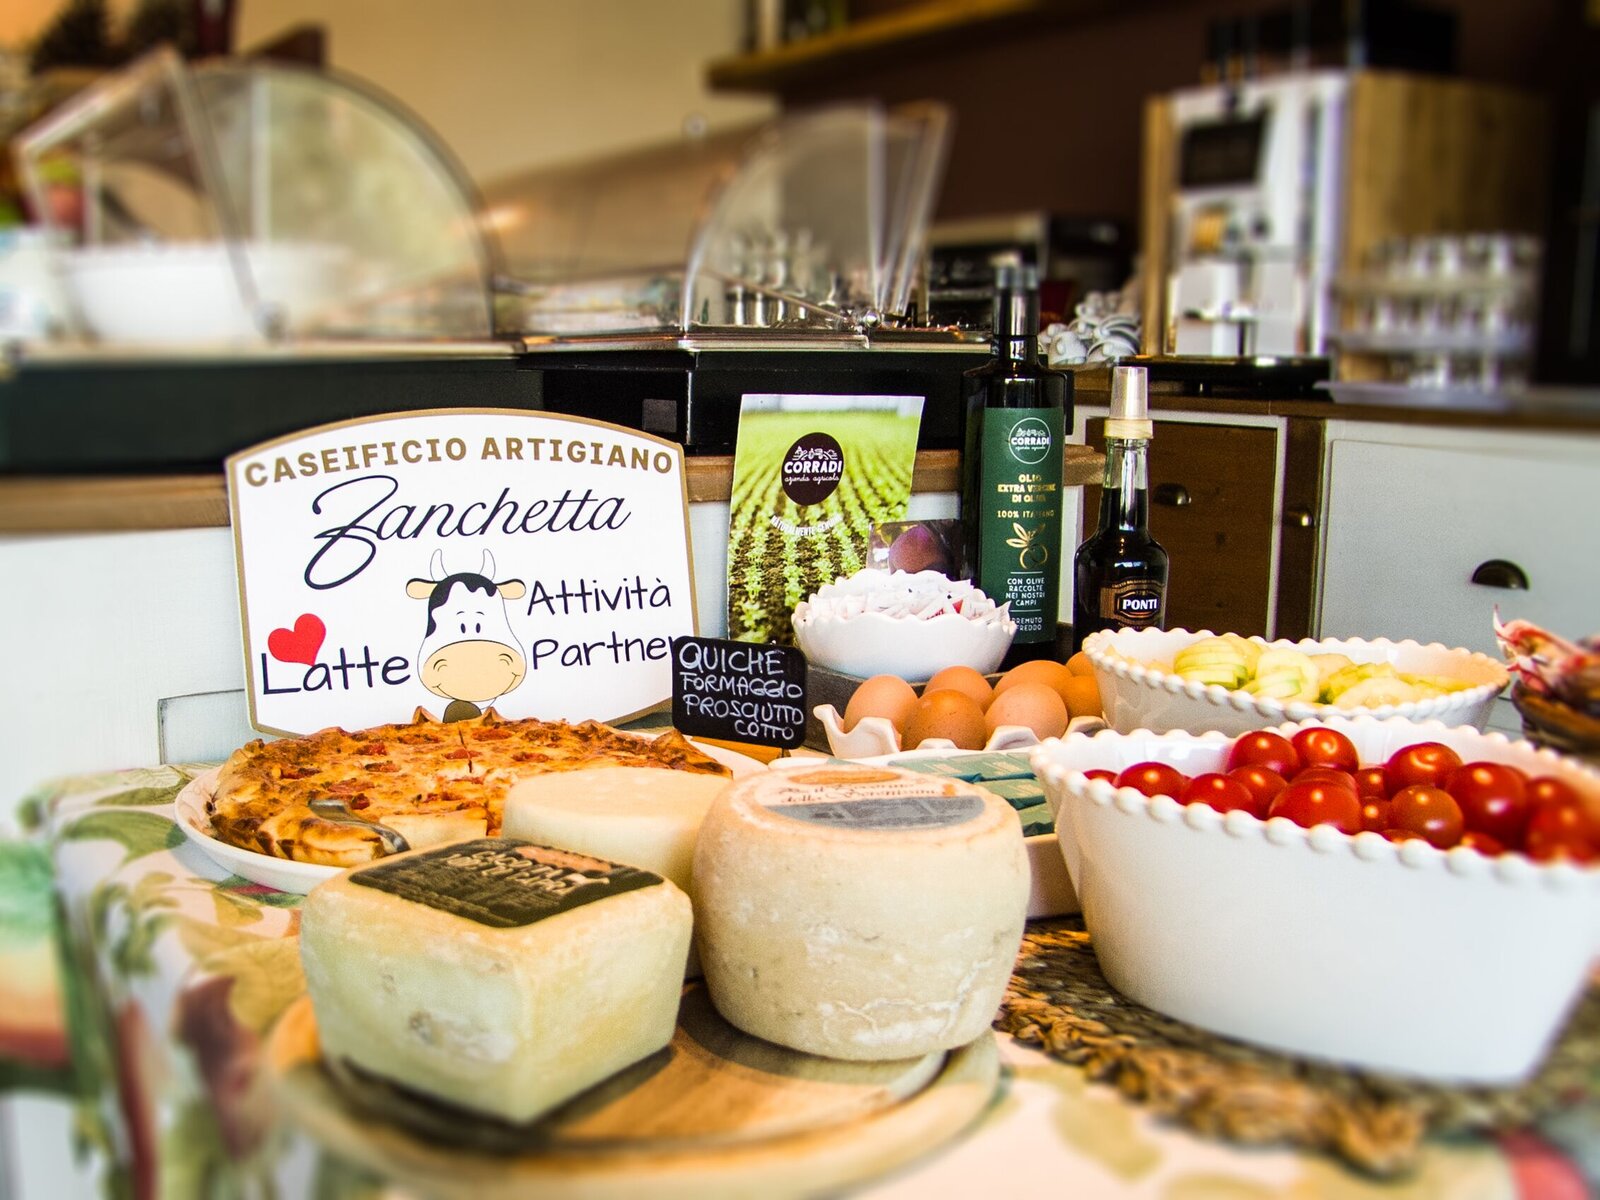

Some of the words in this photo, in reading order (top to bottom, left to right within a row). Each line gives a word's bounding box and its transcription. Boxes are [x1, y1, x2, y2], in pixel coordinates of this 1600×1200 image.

[1011, 437, 1050, 446] CORRADI
[245, 438, 467, 487] CASEIFICIO
[481, 437, 672, 473] ARTIGIANO
[784, 460, 842, 473] CORRADI
[785, 474, 810, 486] azienda
[812, 473, 840, 485] agricola
[1018, 474, 1042, 483] OLIO
[997, 484, 1026, 493] EXTRA
[1012, 494, 1022, 503] DI
[997, 510, 1019, 518] 100%
[304, 475, 632, 590] Zanchetta
[527, 575, 672, 616] Attività
[1005, 592, 1018, 600] NEI
[1122, 599, 1157, 610] PONTI
[680, 642, 785, 675] QUICHE
[261, 646, 411, 695] Latte
[680, 671, 803, 698] FORMAGGIO
[734, 720, 794, 740] COTTO
